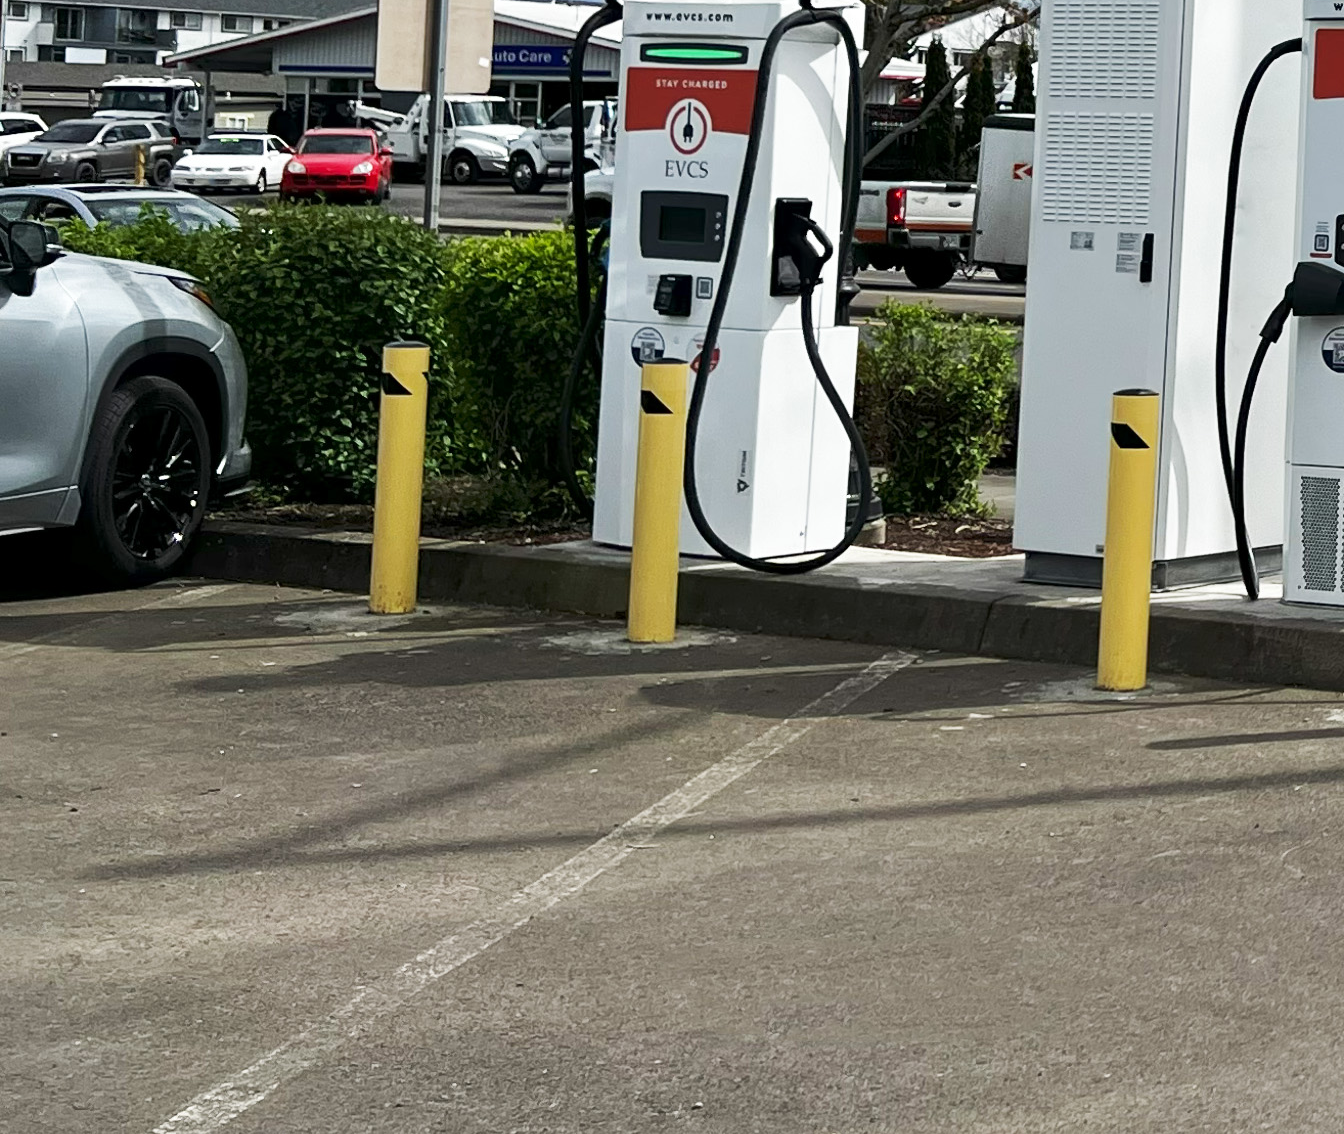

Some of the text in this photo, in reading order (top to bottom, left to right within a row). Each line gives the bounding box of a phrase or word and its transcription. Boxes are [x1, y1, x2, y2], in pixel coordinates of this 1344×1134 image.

[646, 12, 734, 22] www.evcs.com
[491, 49, 552, 63] uto Care
[656, 79, 728, 89] STAY CHARGED
[665, 160, 709, 178] EVCS
